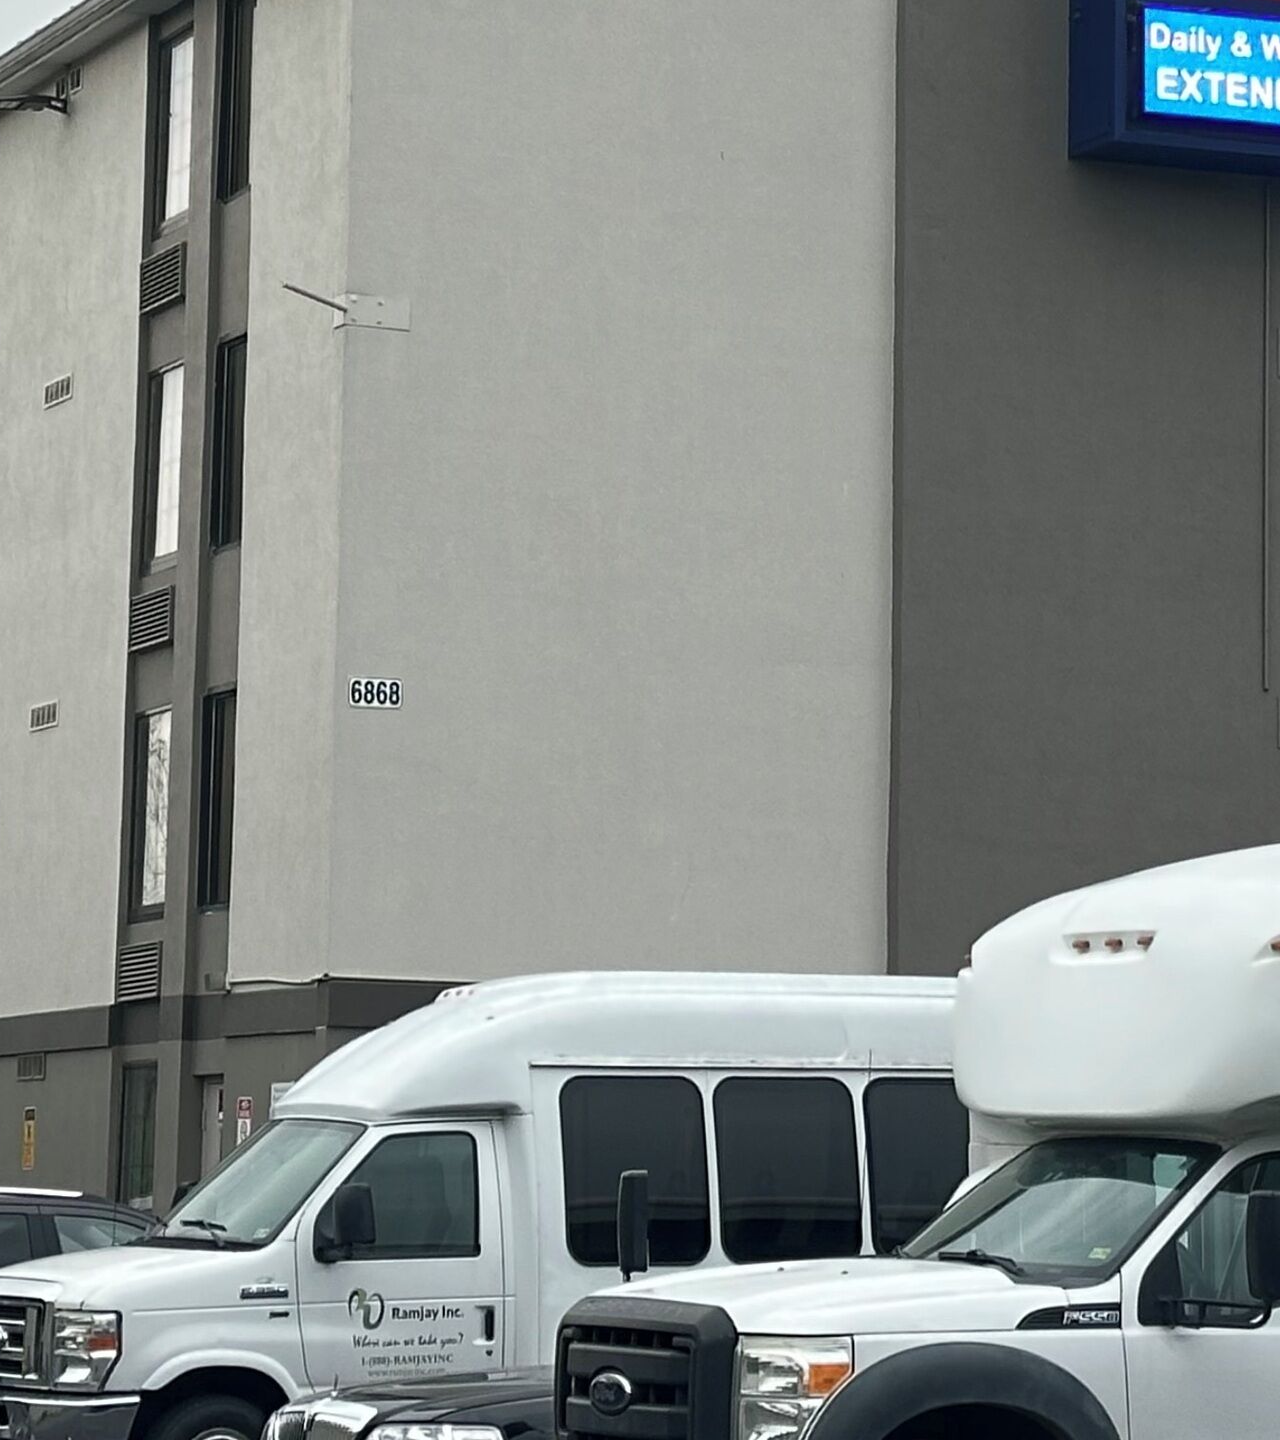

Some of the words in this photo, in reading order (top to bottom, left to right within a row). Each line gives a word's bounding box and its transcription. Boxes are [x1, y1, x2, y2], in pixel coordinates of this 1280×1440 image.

[1148, 22, 1222, 61] Daily
[1229, 30, 1252, 58] &
[351, 680, 400, 705] 6868
[391, 1305, 440, 1321] Ramjay
[441, 1306, 464, 1319] Inc.
